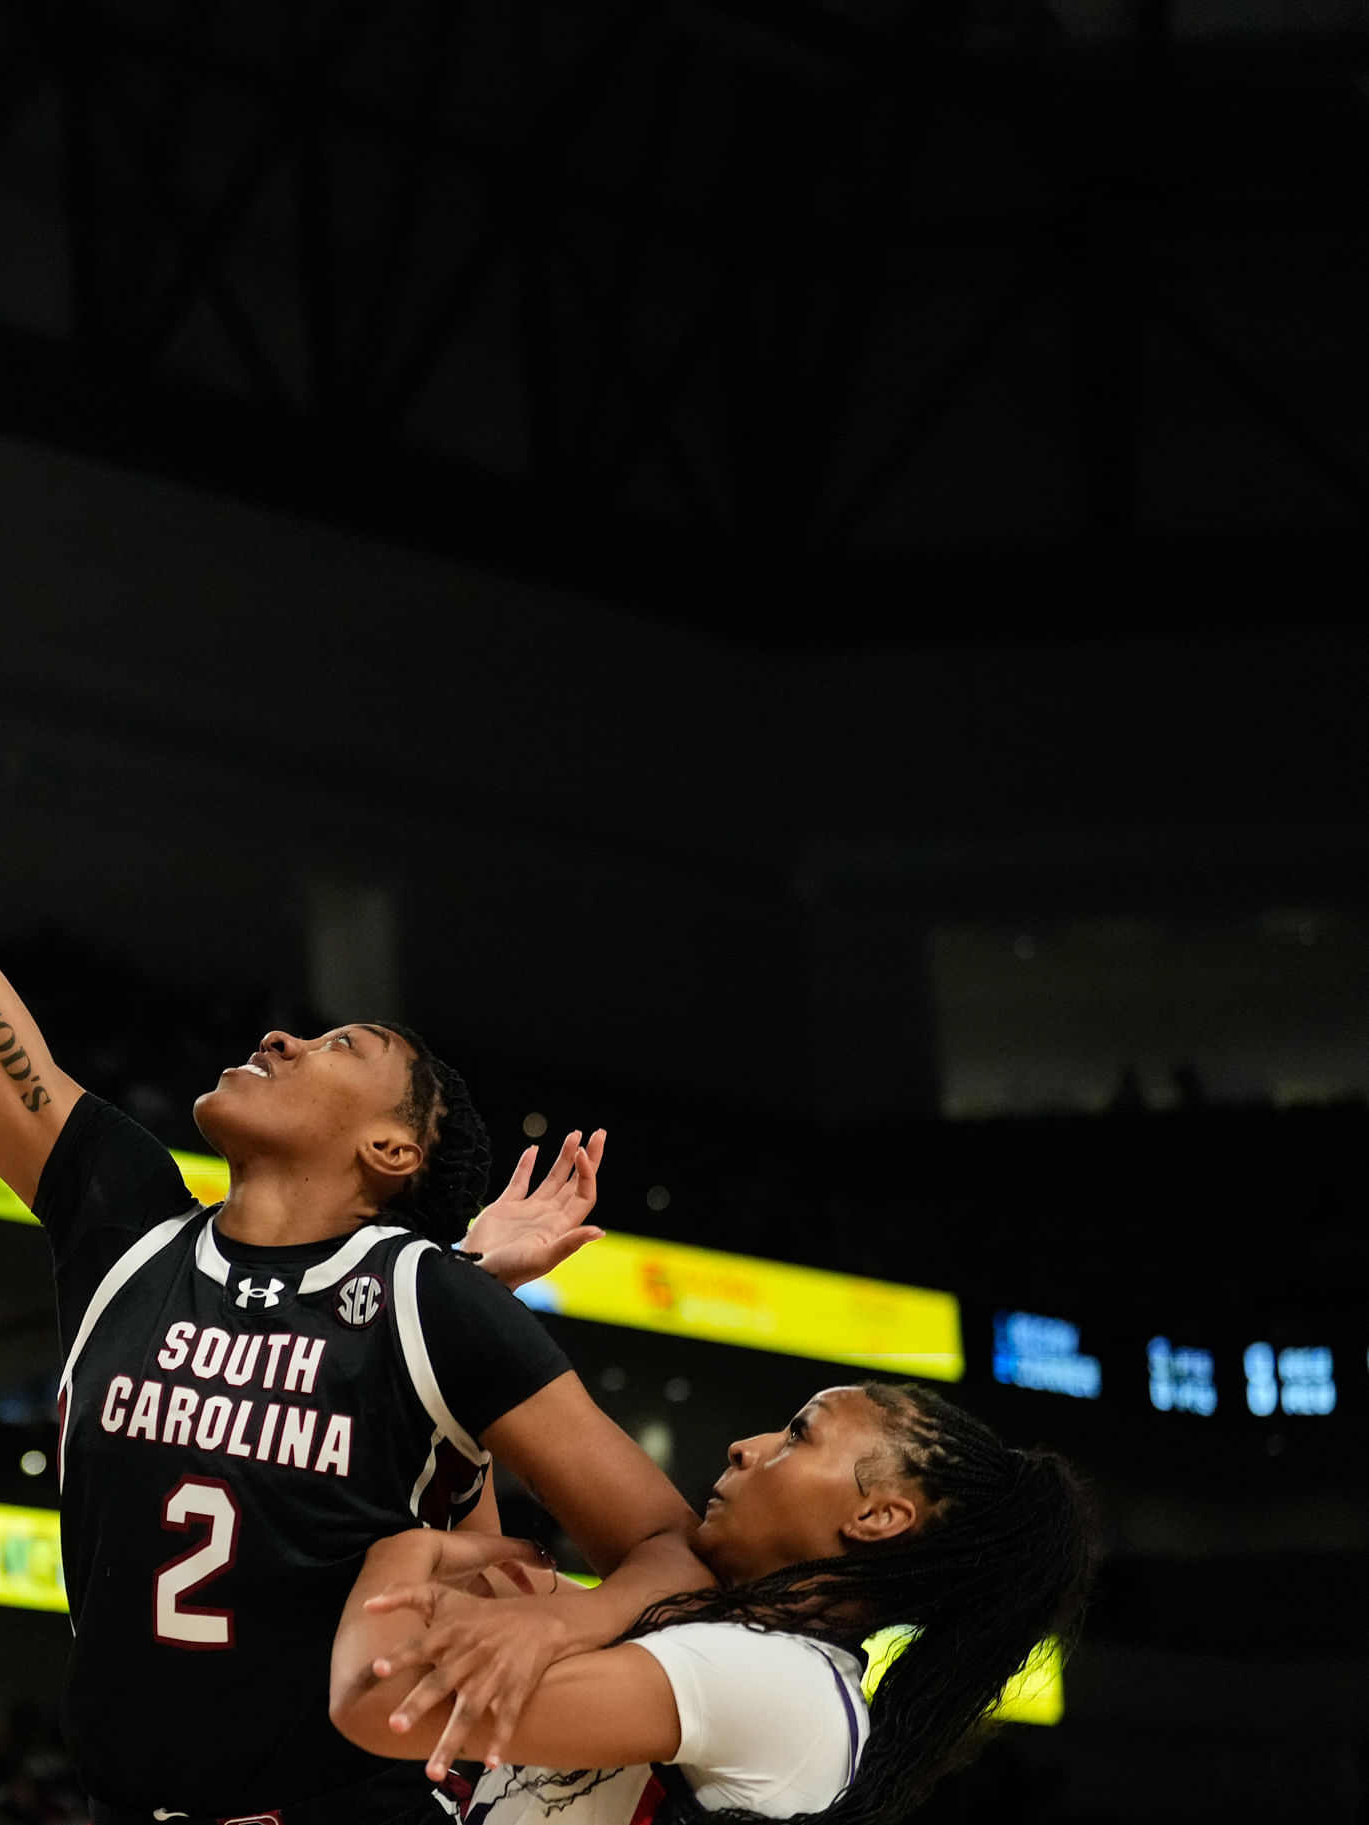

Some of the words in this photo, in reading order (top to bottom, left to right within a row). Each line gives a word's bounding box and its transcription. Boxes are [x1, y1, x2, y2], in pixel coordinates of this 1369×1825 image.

[337, 1275, 382, 1325] SEC
[157, 1321, 327, 1394] SOUTH
[101, 1374, 353, 1478] CAROLINA
[153, 1474, 241, 1650] 2
